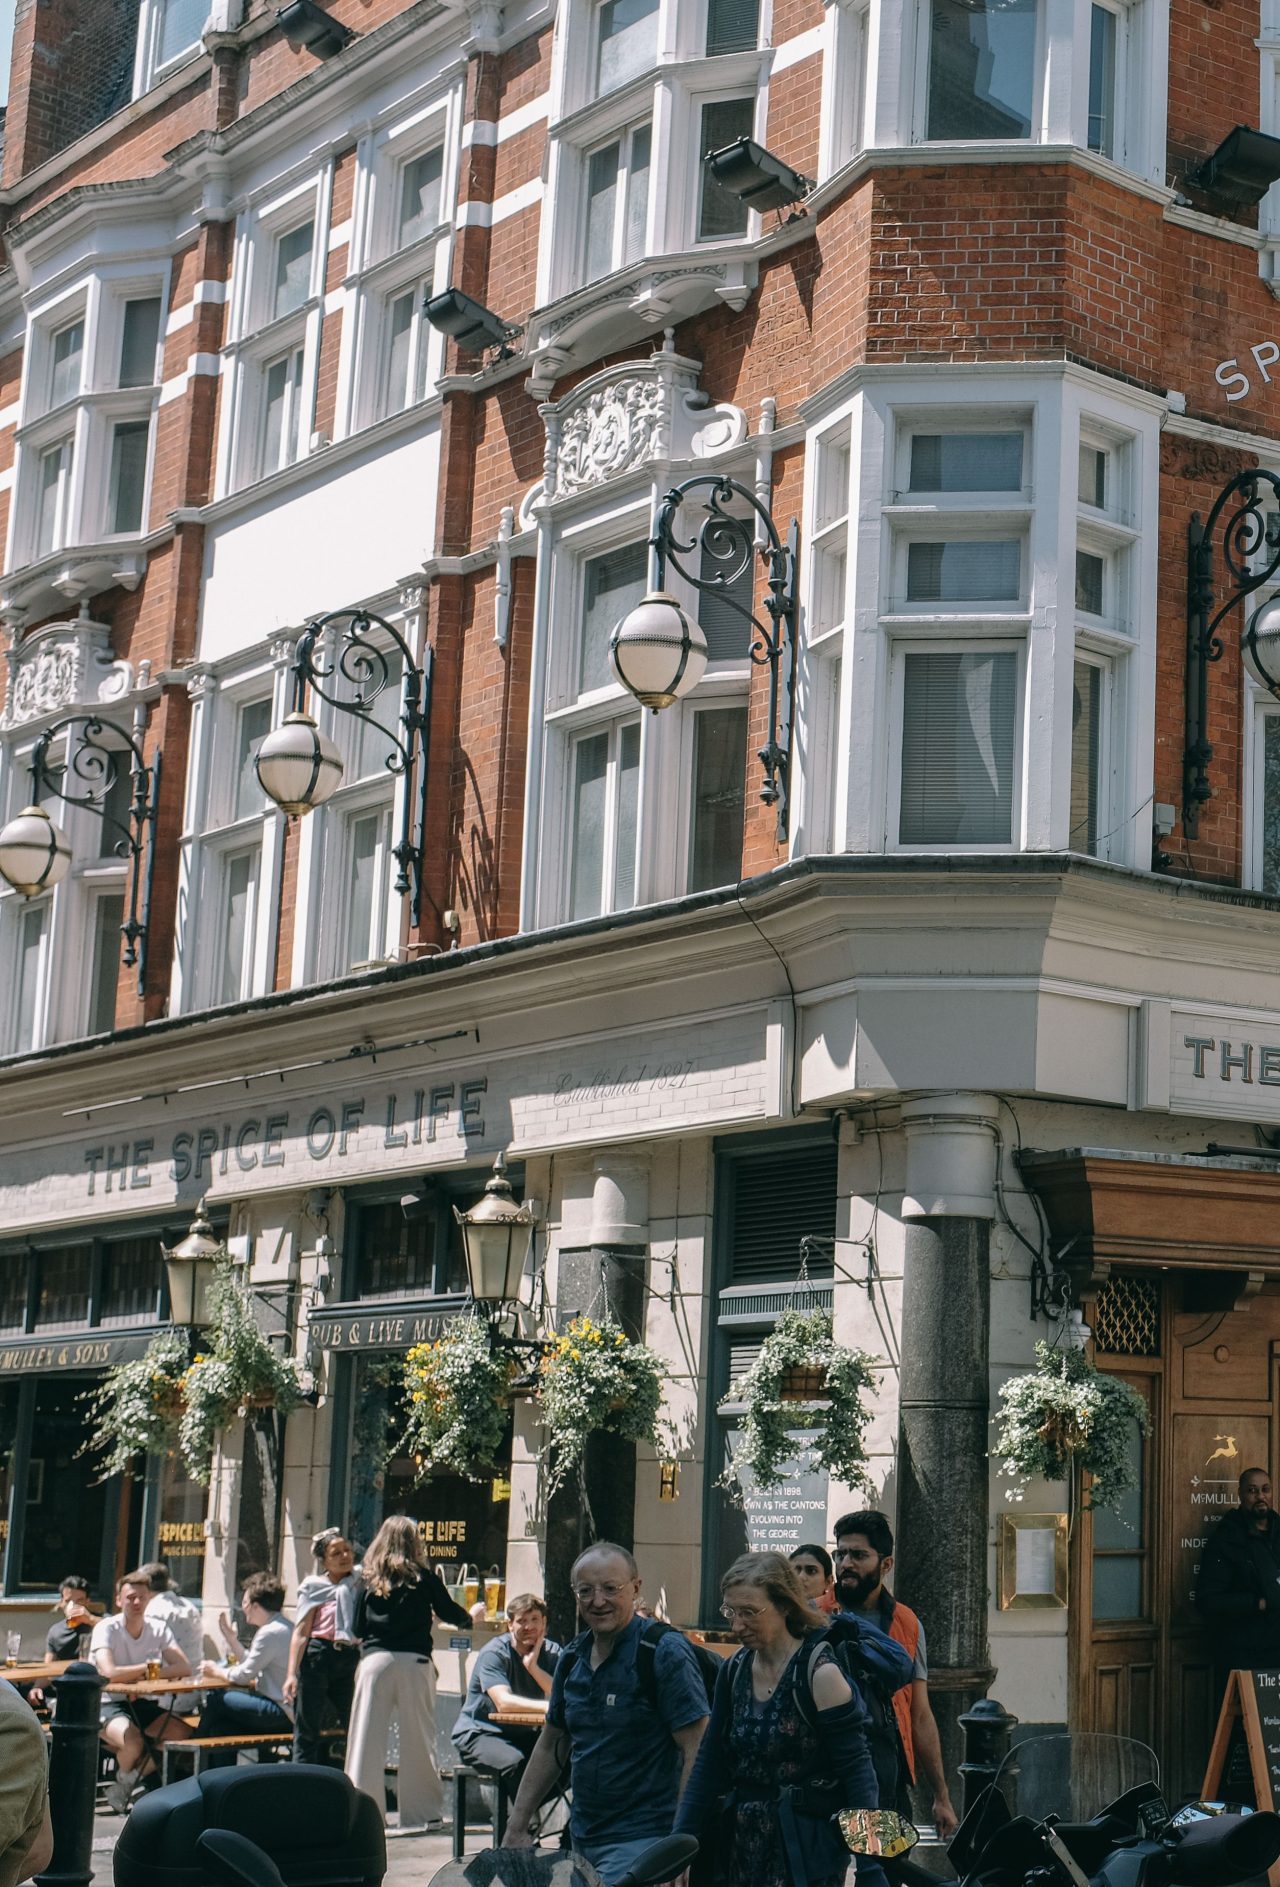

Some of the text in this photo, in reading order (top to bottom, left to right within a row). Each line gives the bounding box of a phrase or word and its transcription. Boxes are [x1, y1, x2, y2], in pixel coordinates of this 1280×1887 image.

[84, 1076, 489, 1196] THE SPICE OF LIFE
[311, 1317, 452, 1346] PUB & LIVE MUS
[58, 1346, 70, 1366] &
[72, 1342, 112, 1364] SONS
[775, 1501, 788, 1510] THE
[162, 1522, 193, 1542] SPICE
[436, 1520, 467, 1542] LIFE
[752, 1529, 767, 1538] THE
[430, 1545, 457, 1557] DINING
[1257, 1673, 1276, 1687] The
